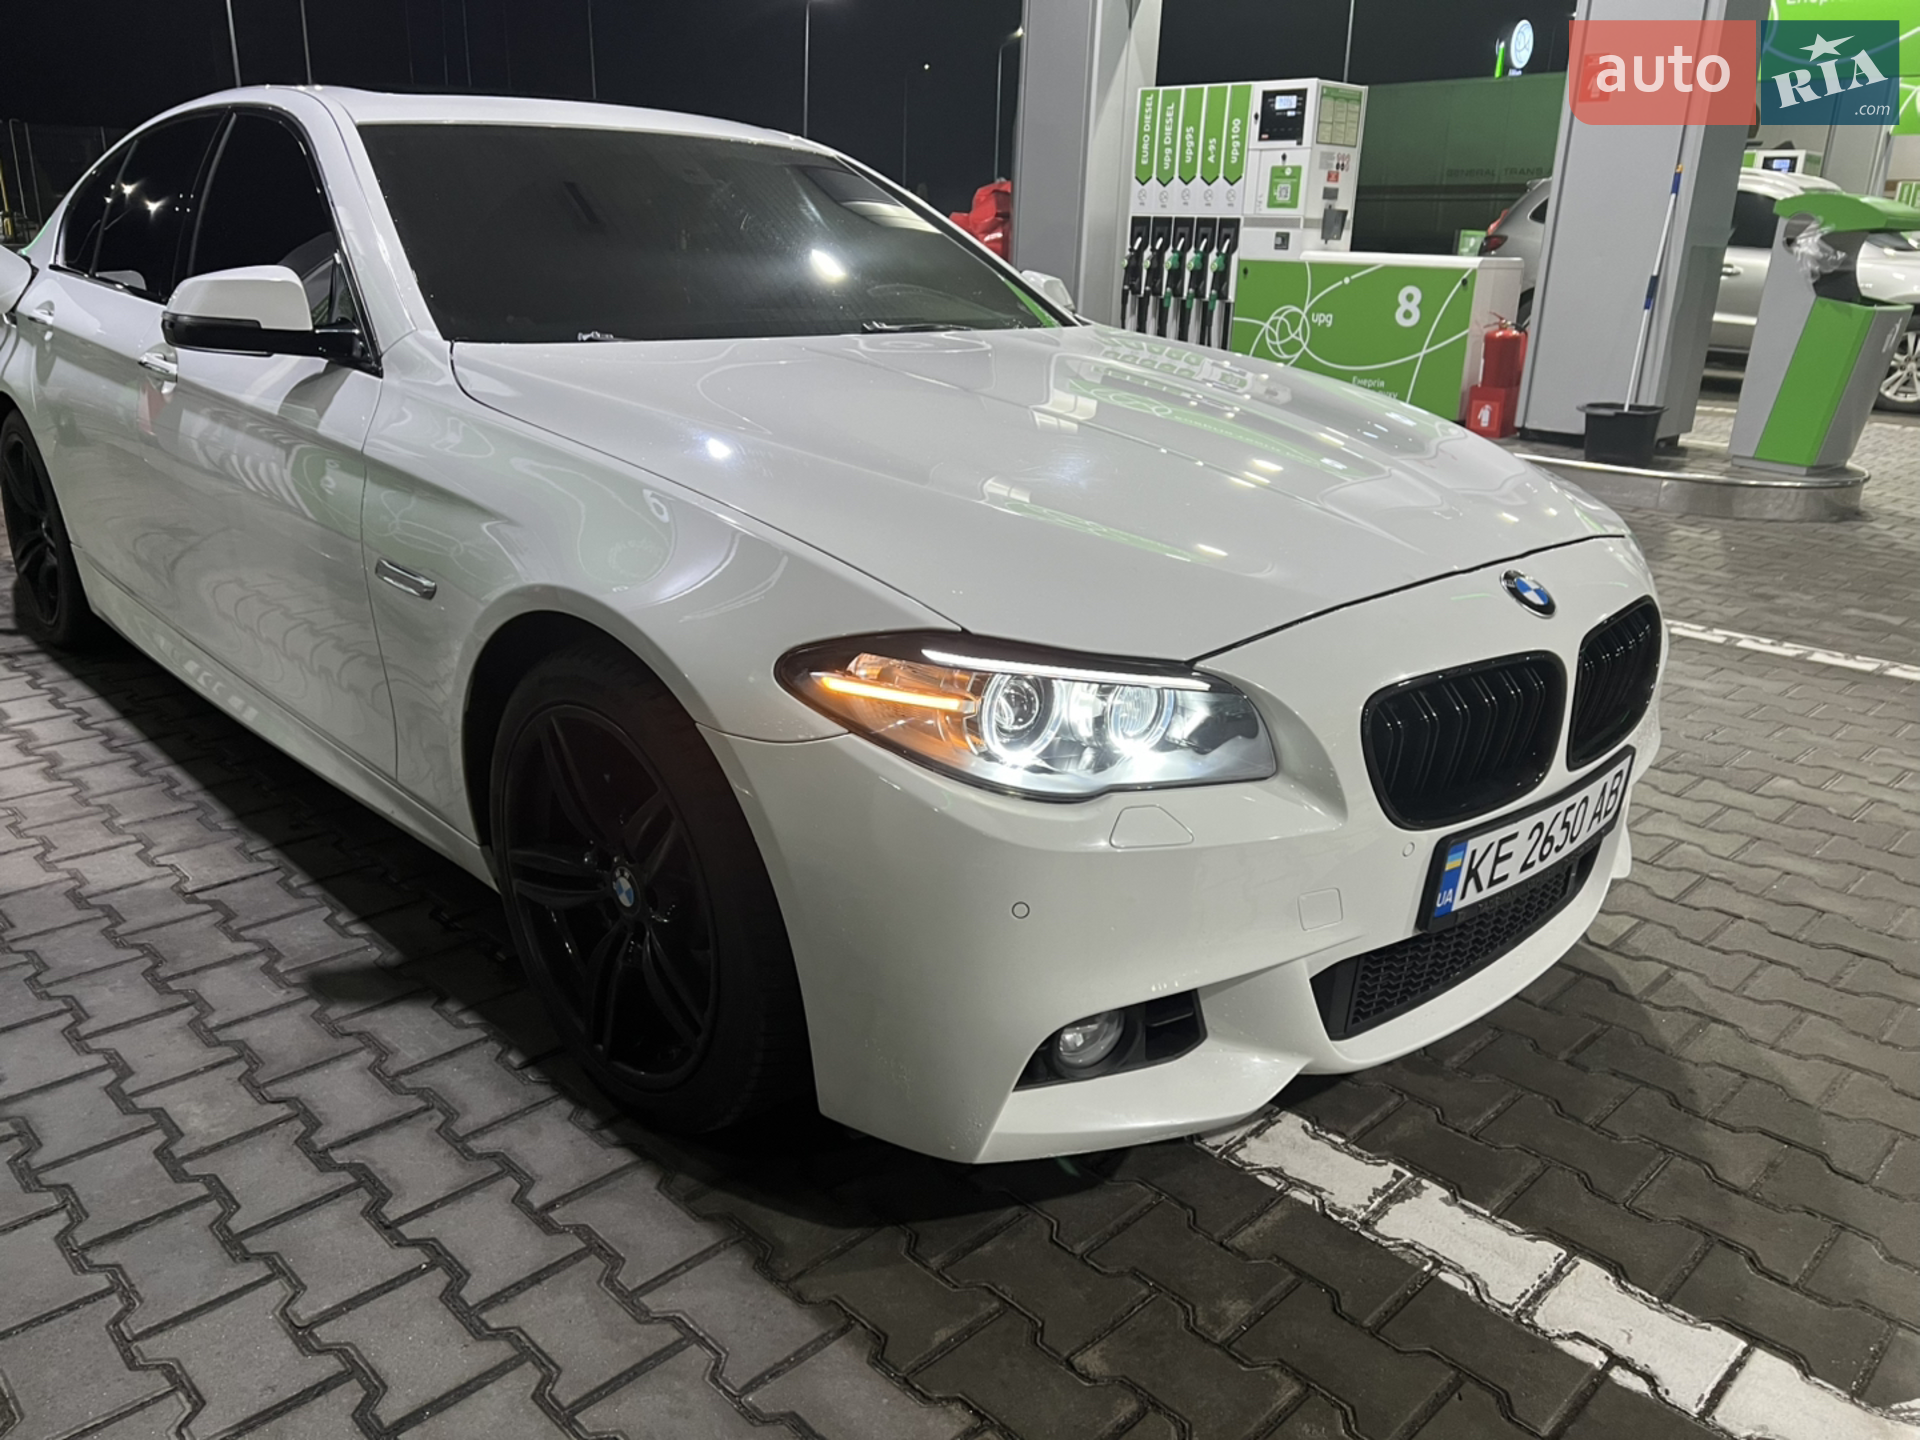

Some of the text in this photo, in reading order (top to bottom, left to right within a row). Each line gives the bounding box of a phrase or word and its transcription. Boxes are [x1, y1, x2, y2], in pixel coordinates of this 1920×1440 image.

[1141, 93, 1154, 165] EURO DIESEL
[1163, 102, 1175, 170] upg DIESEL
[1185, 126, 1195, 163] upg95
[1230, 118, 1241, 164] upg100
[1207, 137, 1217, 164] A-95
[1312, 312, 1333, 327] upg
[1395, 285, 1422, 327] 8
[1460, 769, 1624, 901] KE 2650 AB
[1436, 888, 1453, 908] UA
